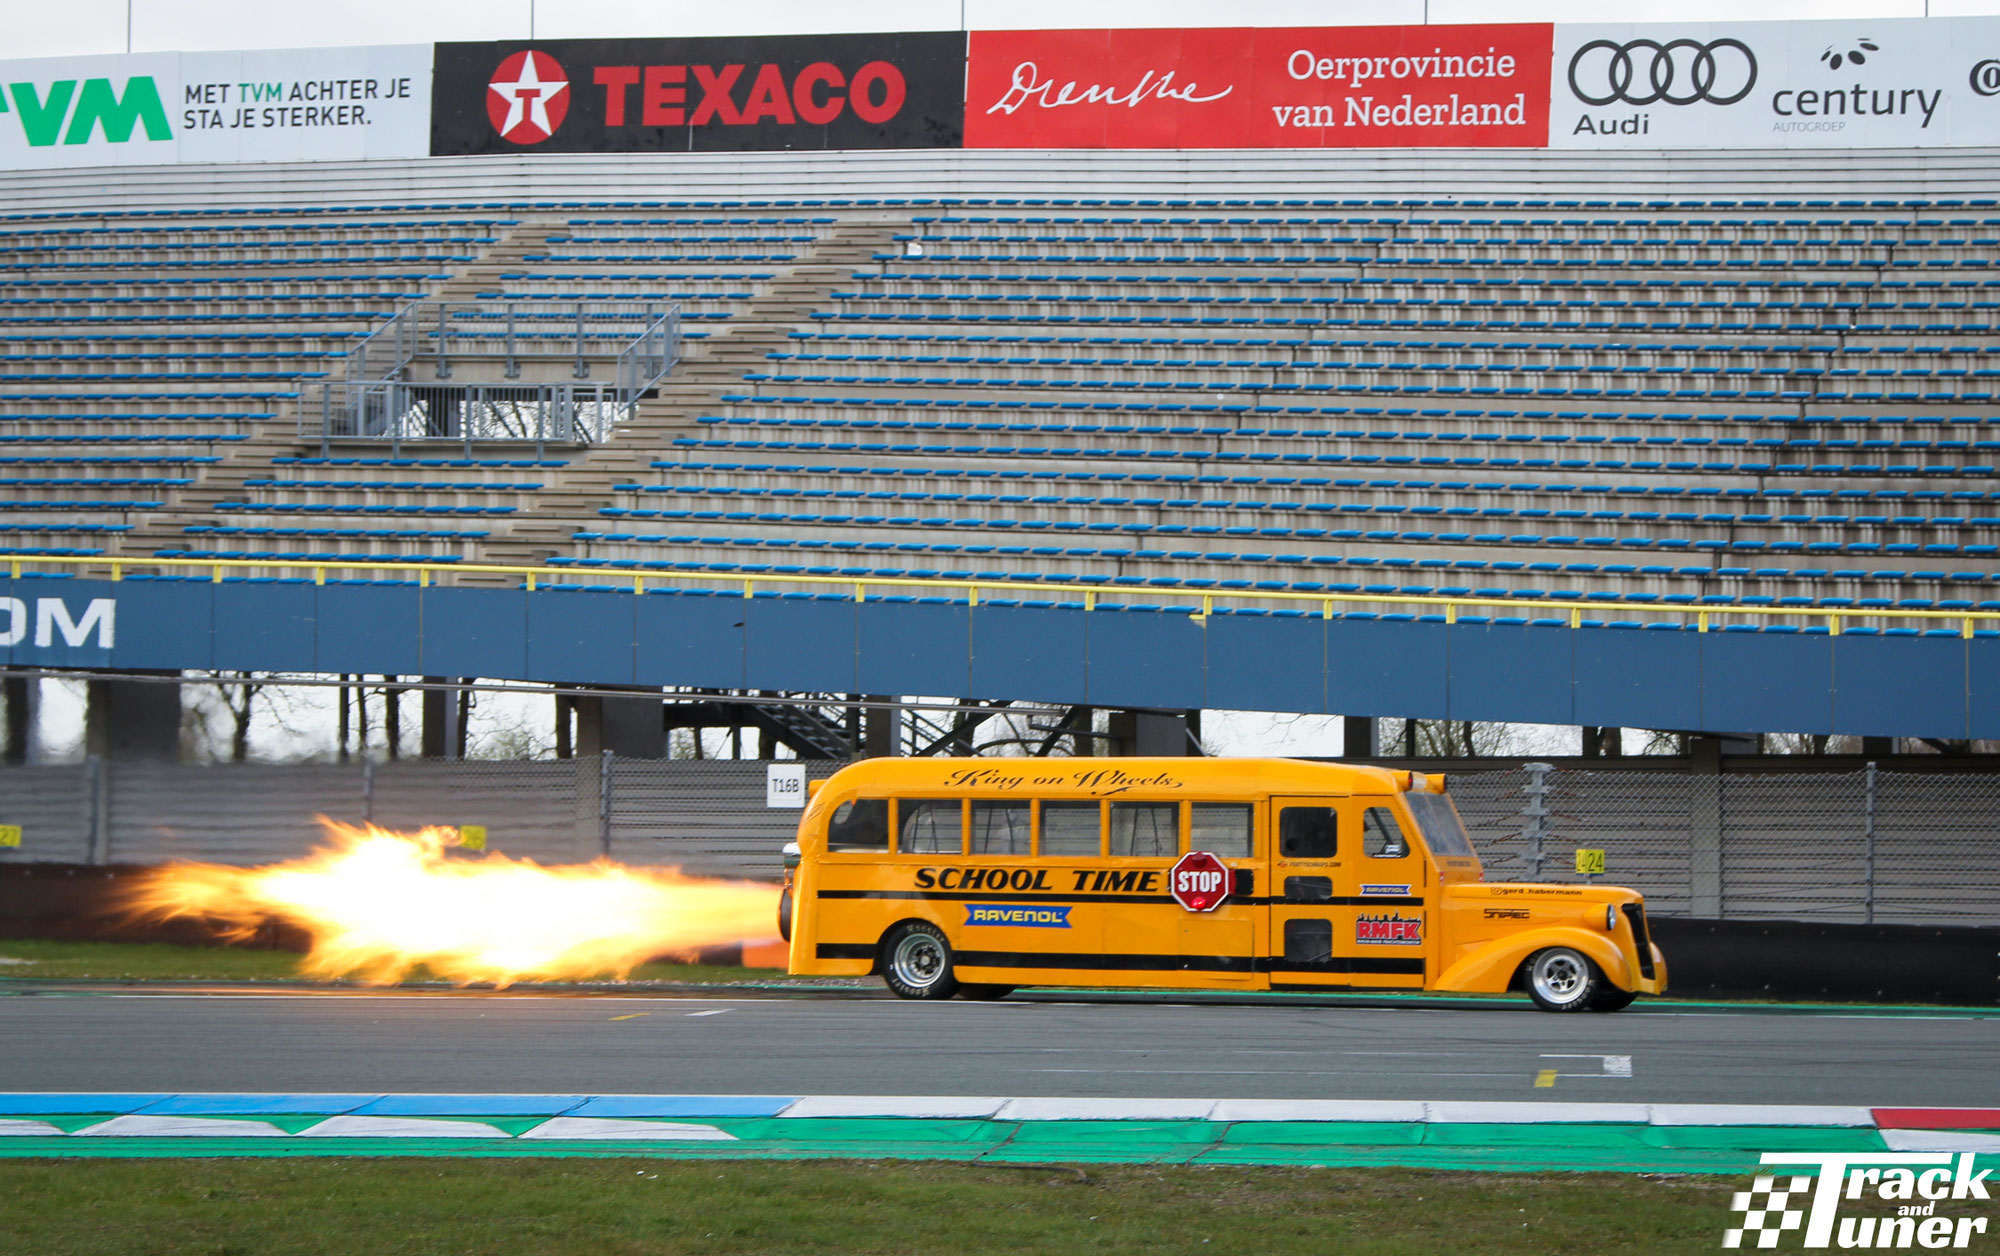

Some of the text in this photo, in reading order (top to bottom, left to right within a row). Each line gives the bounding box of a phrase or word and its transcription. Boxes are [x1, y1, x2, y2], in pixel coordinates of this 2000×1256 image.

[1287, 47, 1516, 88] Oerprovincie
[185, 78, 411, 104] MET TVM ACHTER JE
[593, 60, 907, 127] TEXACO
[986, 61, 1233, 115] Drenthe
[0, 76, 173, 147] VM
[183, 105, 372, 129] STA JE STERKER.
[1272, 93, 1527, 127] van Nederland
[1772, 84, 1942, 129] century
[1573, 114, 1650, 135] Audi
[1773, 121, 1846, 133] AUTOGROEP
[772, 778, 799, 793] T16B
[944, 769, 1183, 796] King on Wheels
[1588, 853, 1603, 871] 24
[914, 868, 1162, 892] SCHOOL TIME
[1178, 871, 1222, 893] STOP
[973, 909, 1063, 923] RAVENOL
[1357, 921, 1421, 940] RMFK
